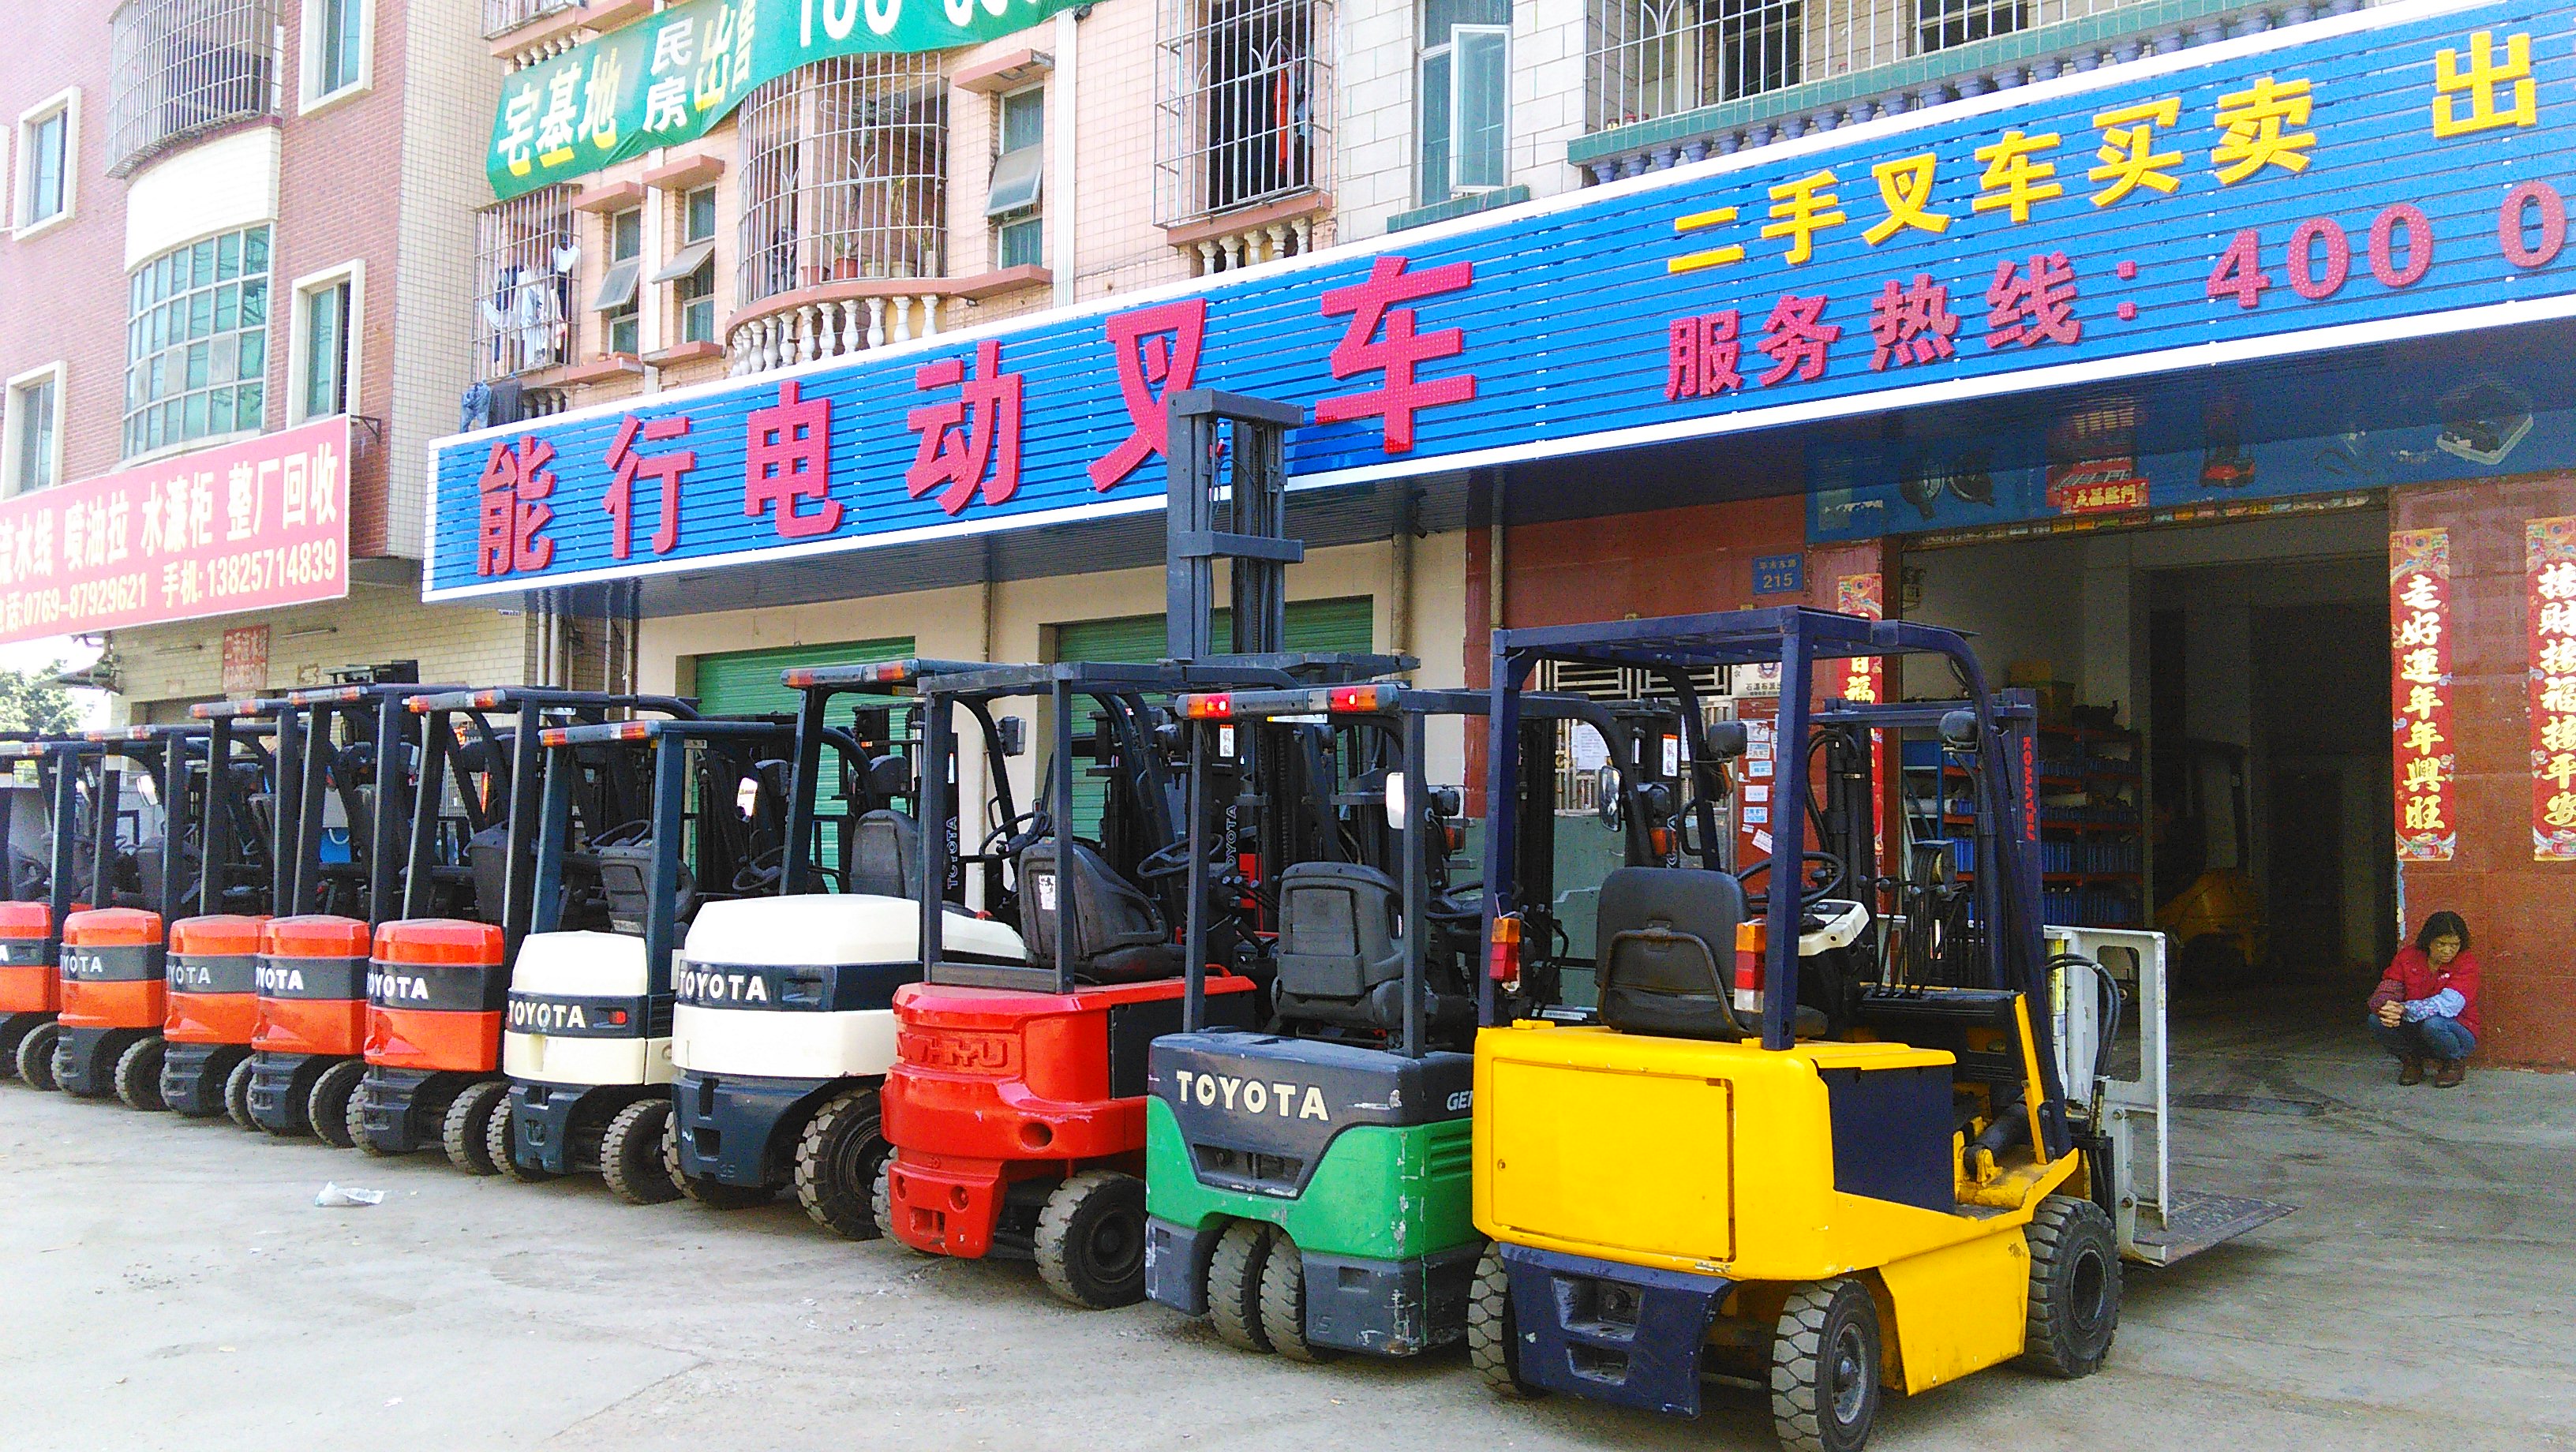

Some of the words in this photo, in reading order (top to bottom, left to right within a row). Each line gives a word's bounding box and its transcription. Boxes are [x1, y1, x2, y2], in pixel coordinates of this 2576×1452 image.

[497, 47, 622, 177] 宅基地
[642, 17, 694, 133] 民房
[1668, 77, 2318, 273] 二手叉车买卖
[2432, 30, 2537, 139] 出
[2206, 203, 2434, 309] 400
[2498, 182, 2567, 269] 0
[476, 255, 1477, 578] 能行电动叉车
[227, 441, 339, 541] 整厂回收
[1762, 573, 1794, 589] 215
[2399, 572, 2447, 831] 走好運年年興旺
[508, 999, 586, 1028] TOYOTA
[680, 971, 767, 1001] TOYOTA
[1175, 1068, 1330, 1121] TOYOTA
